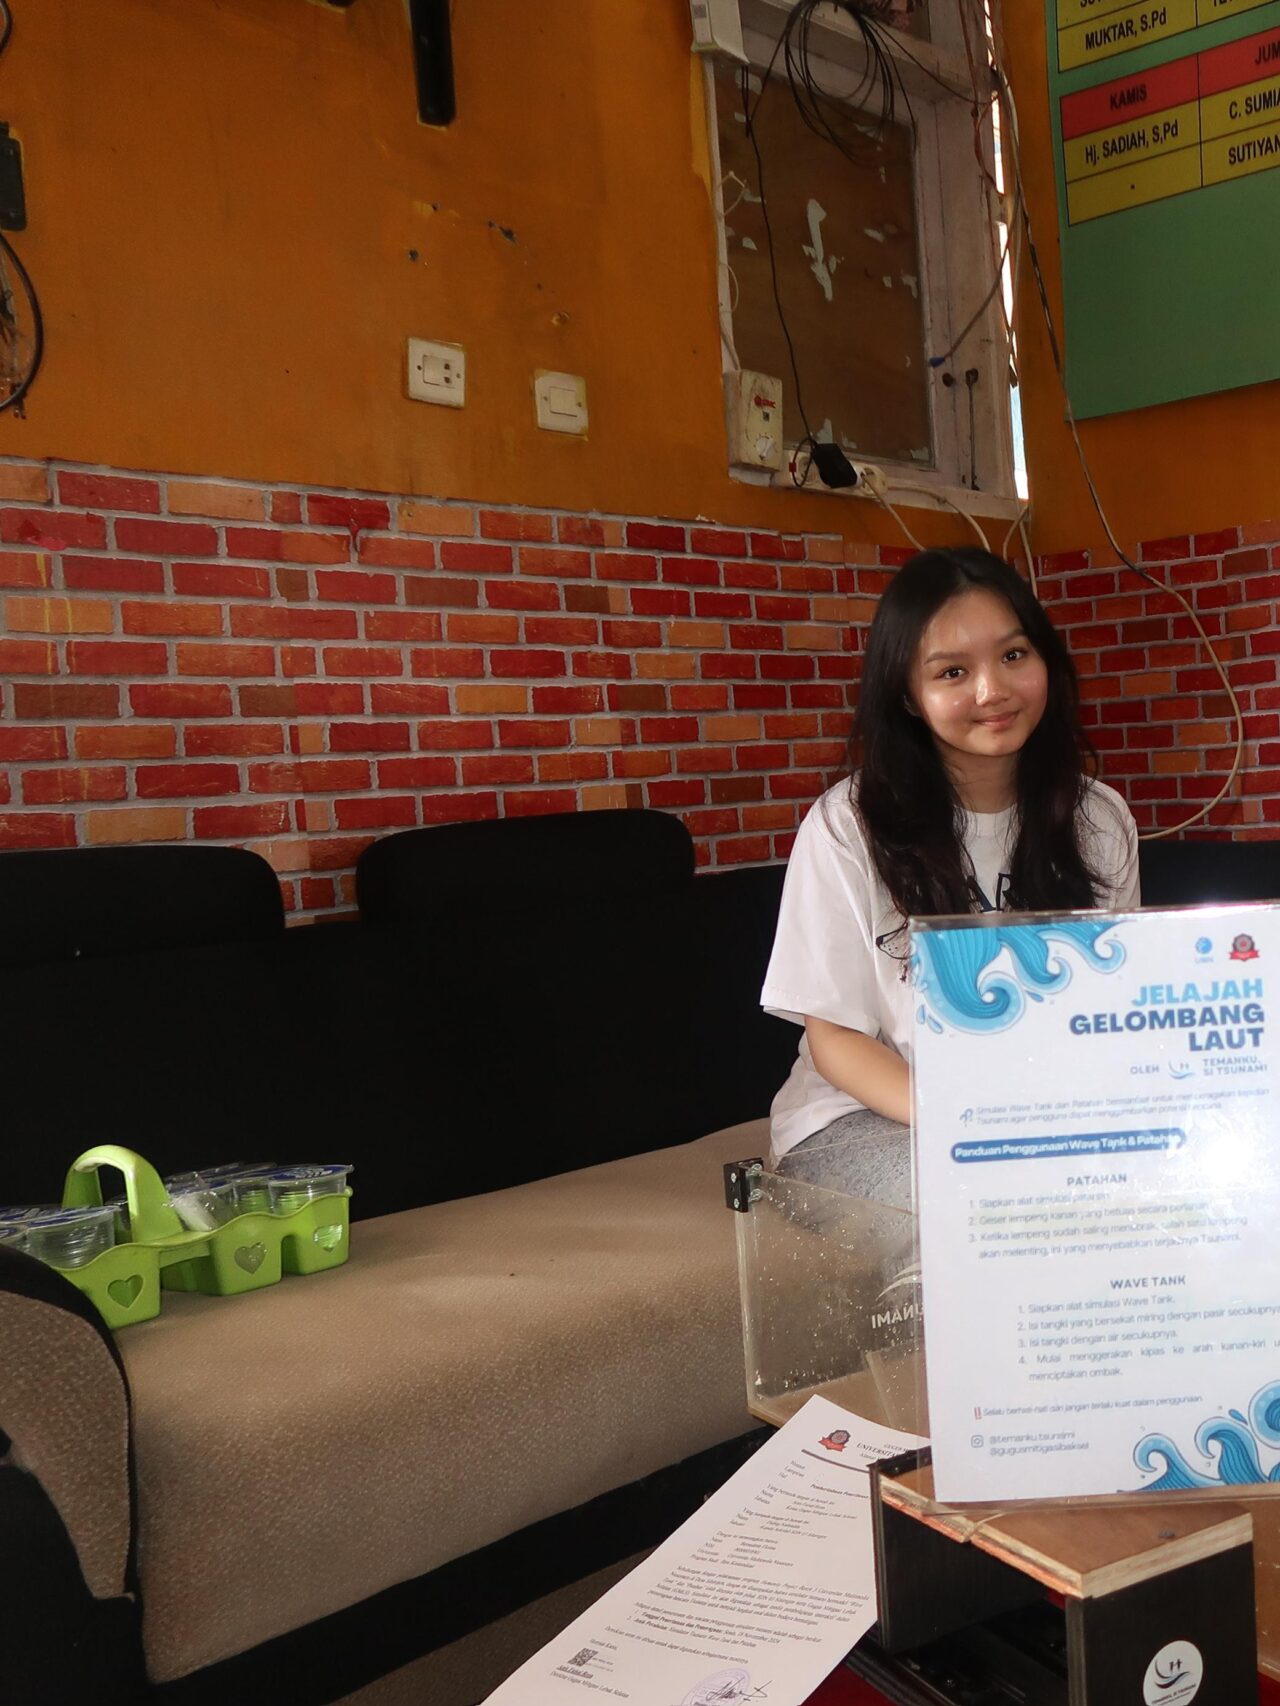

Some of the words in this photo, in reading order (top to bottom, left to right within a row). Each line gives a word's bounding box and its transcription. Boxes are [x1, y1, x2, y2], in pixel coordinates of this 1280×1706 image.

[1085, 19, 1137, 50] MUKTAR,
[1140, 8, 1167, 31] S.Pd
[1110, 84, 1147, 111] KAMIS
[1229, 101, 1241, 119] C.
[1085, 146, 1100, 165] Hj.
[1103, 131, 1149, 158] SADIAH,
[1131, 978, 1264, 1007] JELAJAH
[1069, 1003, 1266, 1036] GELOMBANG
[1188, 1027, 1265, 1053] LAUT
[1129, 1064, 1160, 1076] OLEH
[1216, 1063, 1268, 1075] TSUNAMI
[955, 1145, 1001, 1158] Panduan
[1002, 1141, 1069, 1157] Penggunaan
[1066, 1174, 1128, 1187] PATAHAN
[979, 1214, 1006, 1225] Geser
[1109, 1277, 1149, 1290] WAVE
[1151, 1274, 1186, 1288] TANK
[1028, 1302, 1064, 1315] Siapkan
[1066, 1300, 1083, 1311] alat
[1084, 1297, 1121, 1309] simulasi
[1121, 1296, 1149, 1307] Wave
[1040, 1317, 1068, 1331] tangki
[1070, 1317, 1094, 1330] yang
[1095, 1313, 1134, 1327] bersekat
[1136, 1311, 1166, 1324] miring
[1167, 1309, 1202, 1322] dengan
[1203, 1307, 1225, 1320] pasir
[1040, 1334, 1069, 1348] tangki
[1070, 1331, 1106, 1346] dengan
[1107, 1330, 1118, 1341] air
[1036, 1353, 1061, 1364] Mulai
[1172, 1343, 1185, 1354] ke
[1191, 1342, 1213, 1353] arah
[1028, 1367, 1087, 1381] menciptakan
